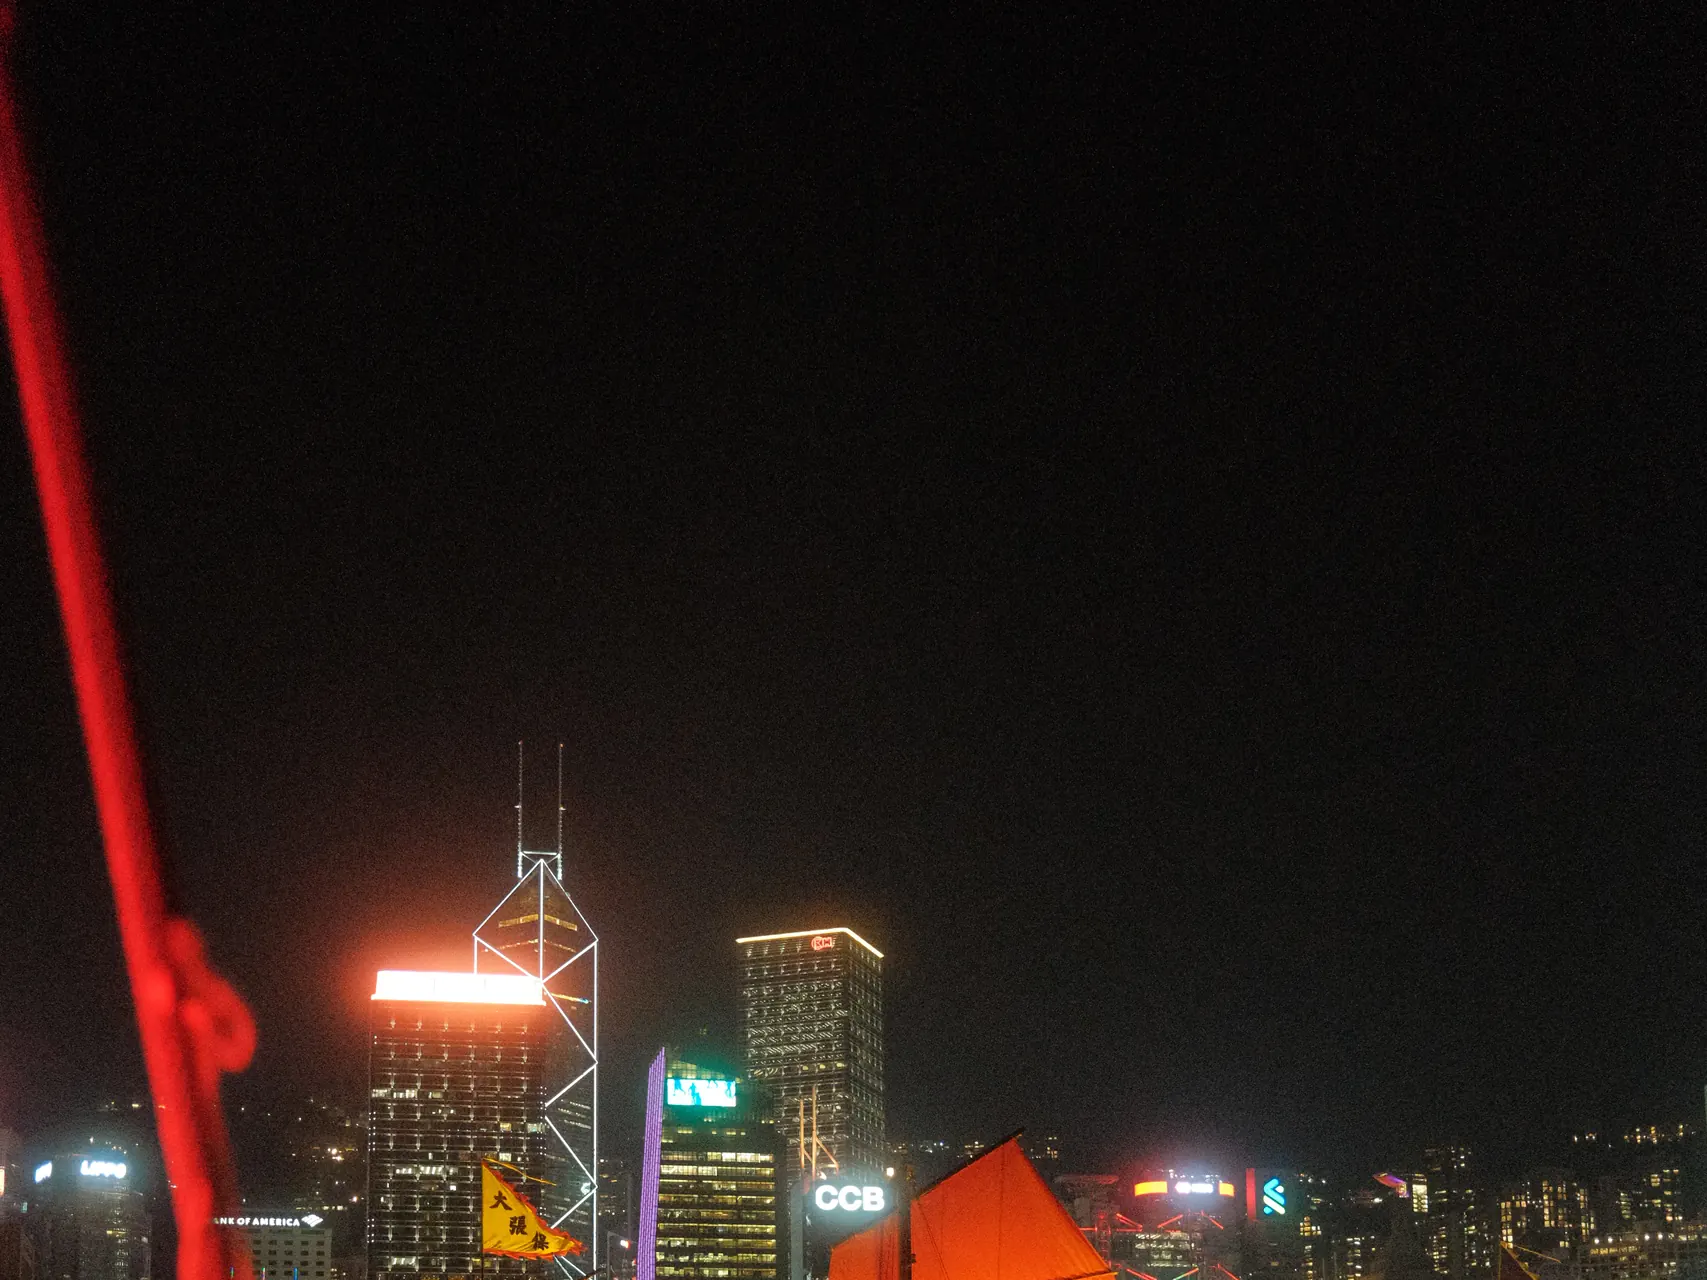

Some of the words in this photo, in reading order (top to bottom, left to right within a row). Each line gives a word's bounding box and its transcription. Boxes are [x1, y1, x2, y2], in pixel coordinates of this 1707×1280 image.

[815, 1184, 885, 1211] CCB
[213, 1217, 235, 1225] ANK
[236, 1217, 251, 1225] OF
[252, 1217, 300, 1227] AMERICA
